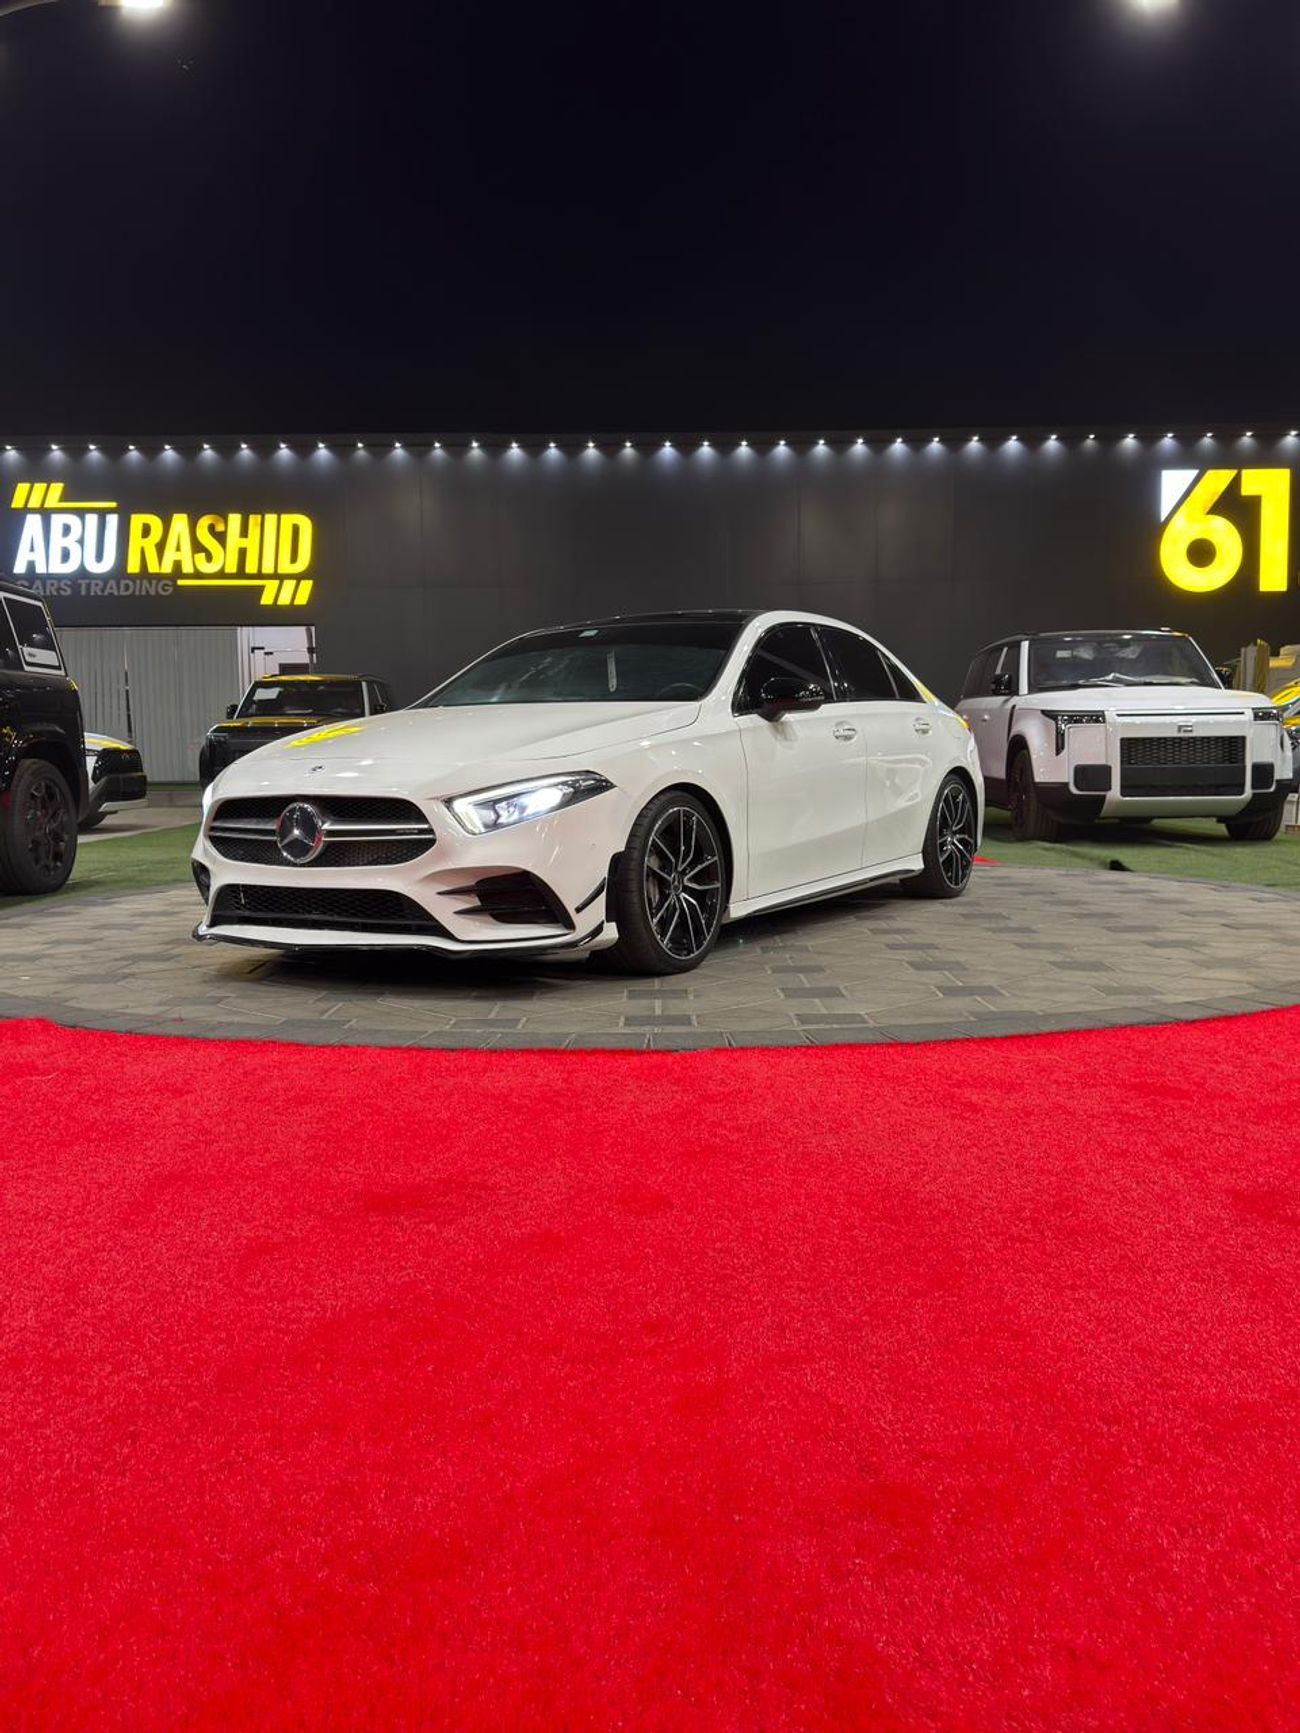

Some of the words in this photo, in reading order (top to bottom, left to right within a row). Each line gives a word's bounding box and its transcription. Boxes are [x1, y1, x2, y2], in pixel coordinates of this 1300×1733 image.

[13, 513, 119, 574] ABU
[126, 513, 313, 574] RASHID
[1160, 468, 1291, 593] 61
[78, 579, 174, 596] TRADING
